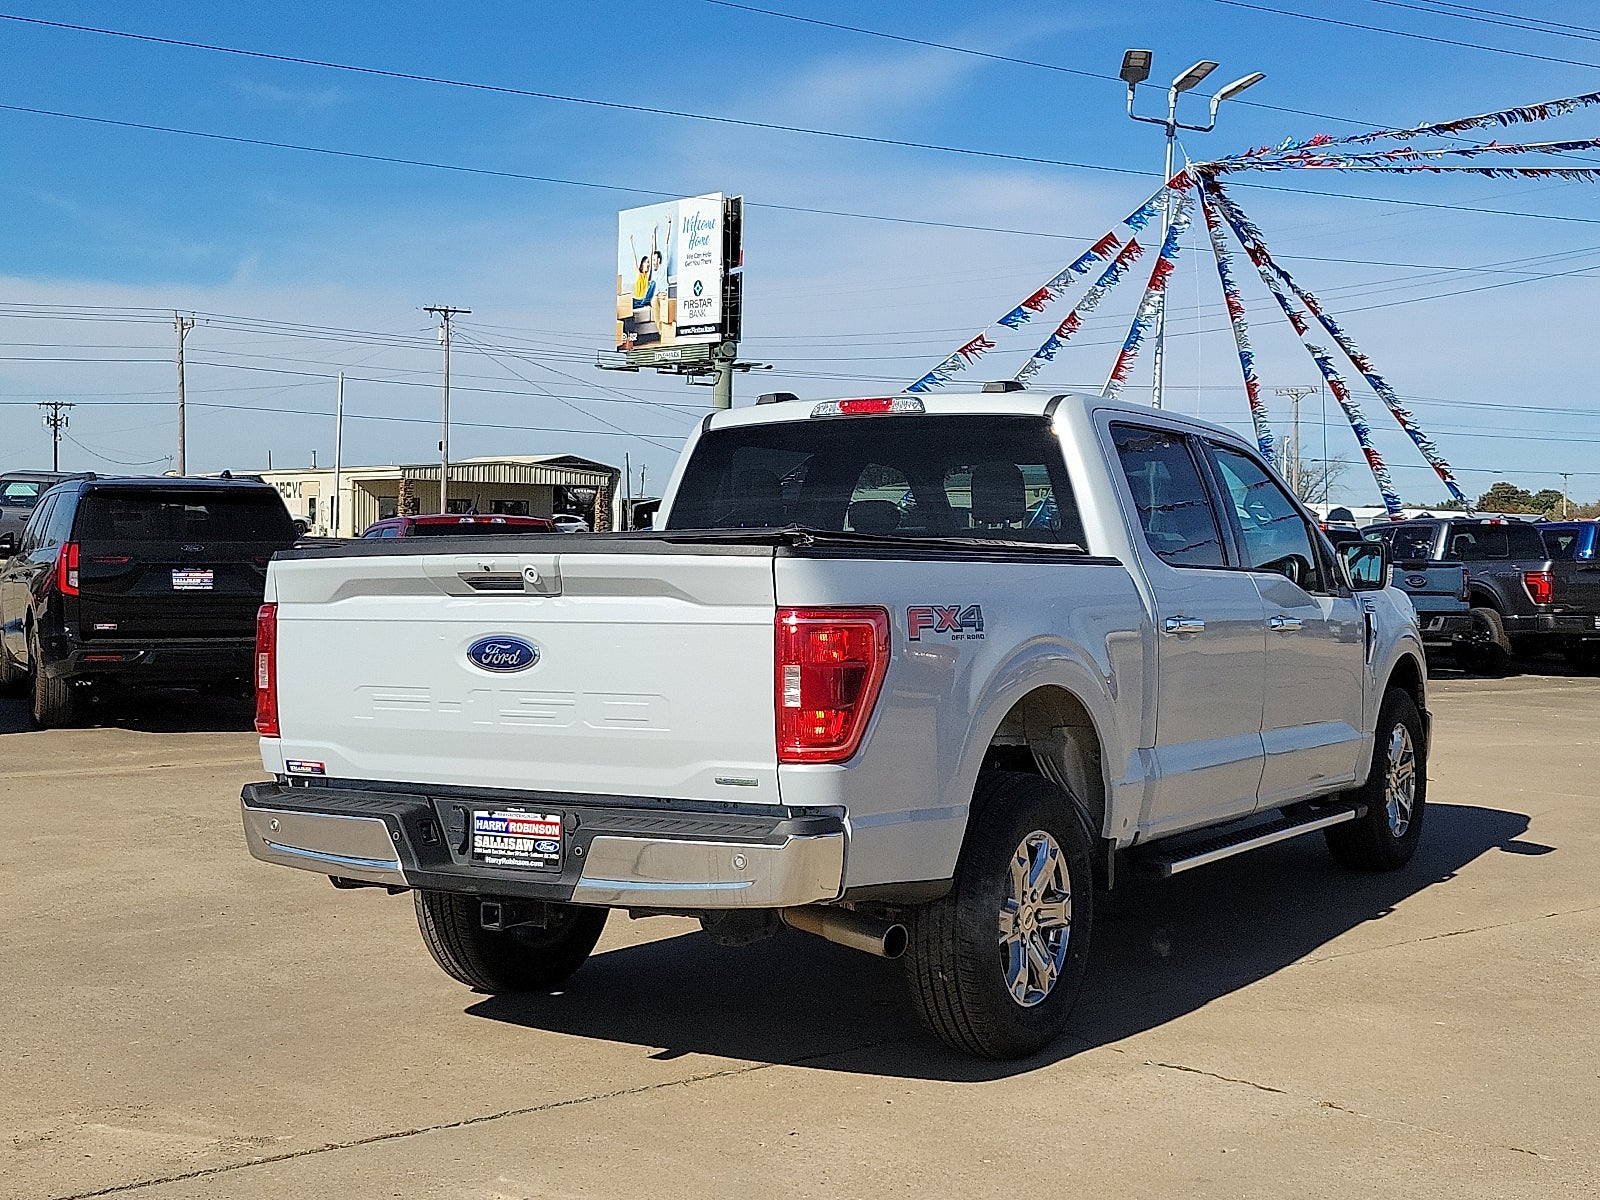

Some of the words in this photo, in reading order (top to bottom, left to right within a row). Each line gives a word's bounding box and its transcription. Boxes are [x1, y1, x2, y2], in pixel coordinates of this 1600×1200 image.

[689, 232, 710, 250] Home
[685, 260, 693, 268] Get
[684, 298, 713, 310] FIRSTAR
[689, 309, 707, 319] BANK
[906, 604, 985, 642] FX4
[481, 643, 521, 665] Ford
[476, 820, 508, 832] HARRY
[509, 822, 560, 836] ROBINSON
[474, 835, 535, 852] SALLISAW
